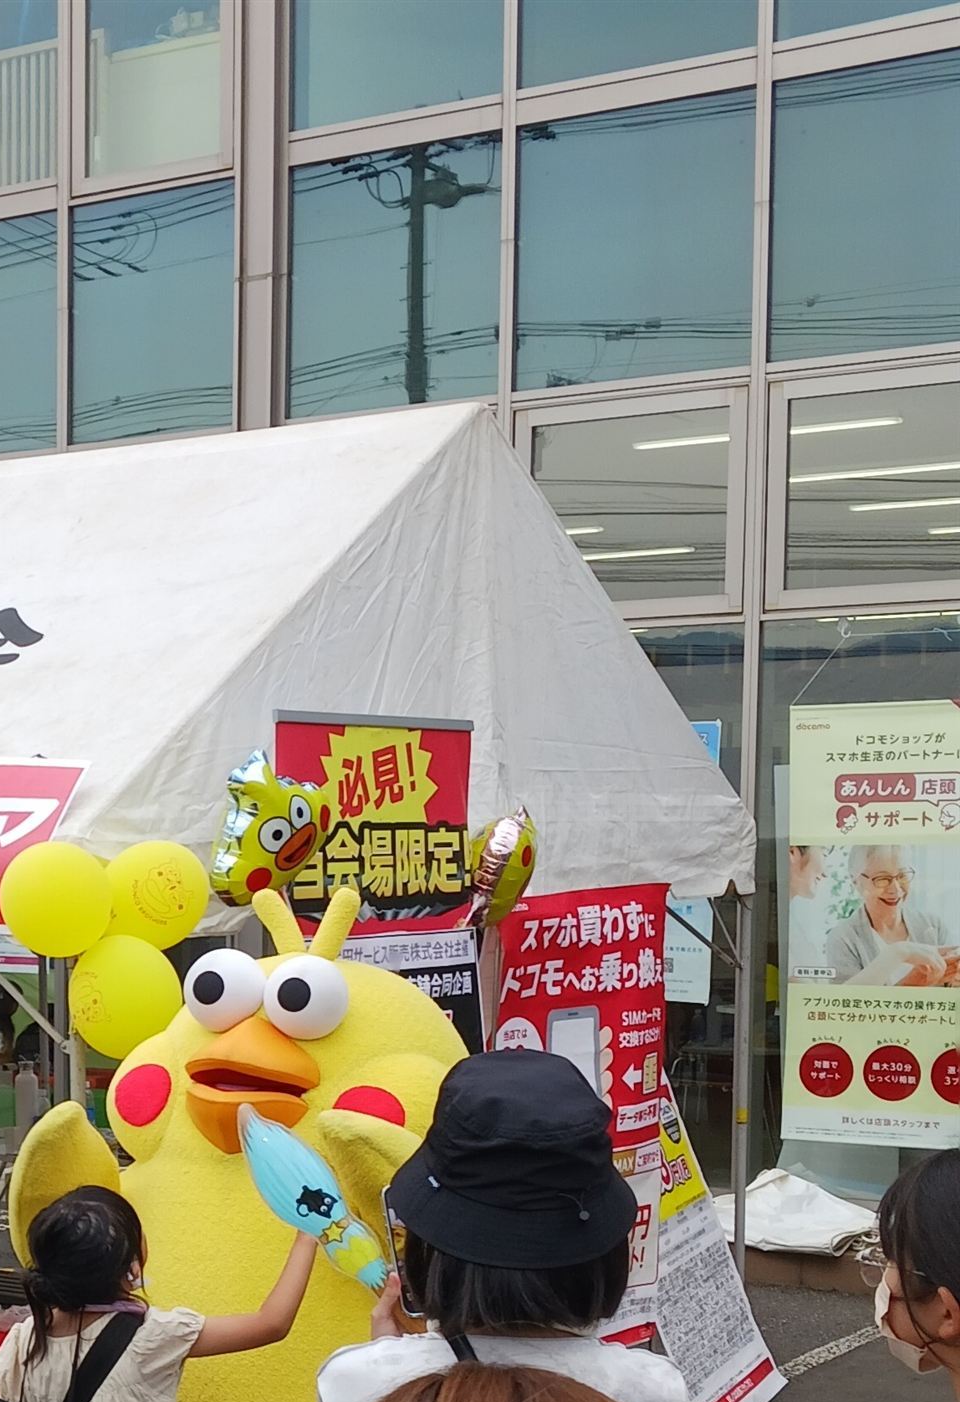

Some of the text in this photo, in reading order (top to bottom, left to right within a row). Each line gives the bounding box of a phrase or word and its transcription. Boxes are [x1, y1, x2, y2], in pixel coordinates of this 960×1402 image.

[796, 722, 831, 731] docomo
[855, 732, 947, 746] ドコモショップが
[338, 742, 417, 820] 必見!
[840, 778, 957, 796] あんしん 店頭
[865, 810, 933, 827] サポート
[521, 901, 656, 952] スマホ買わずに
[500, 948, 663, 1004] ドコモへお乗り換え
[810, 1071, 842, 1081] サポート
[842, 1116, 941, 1130] 詳しくは店頭スタッフまで
